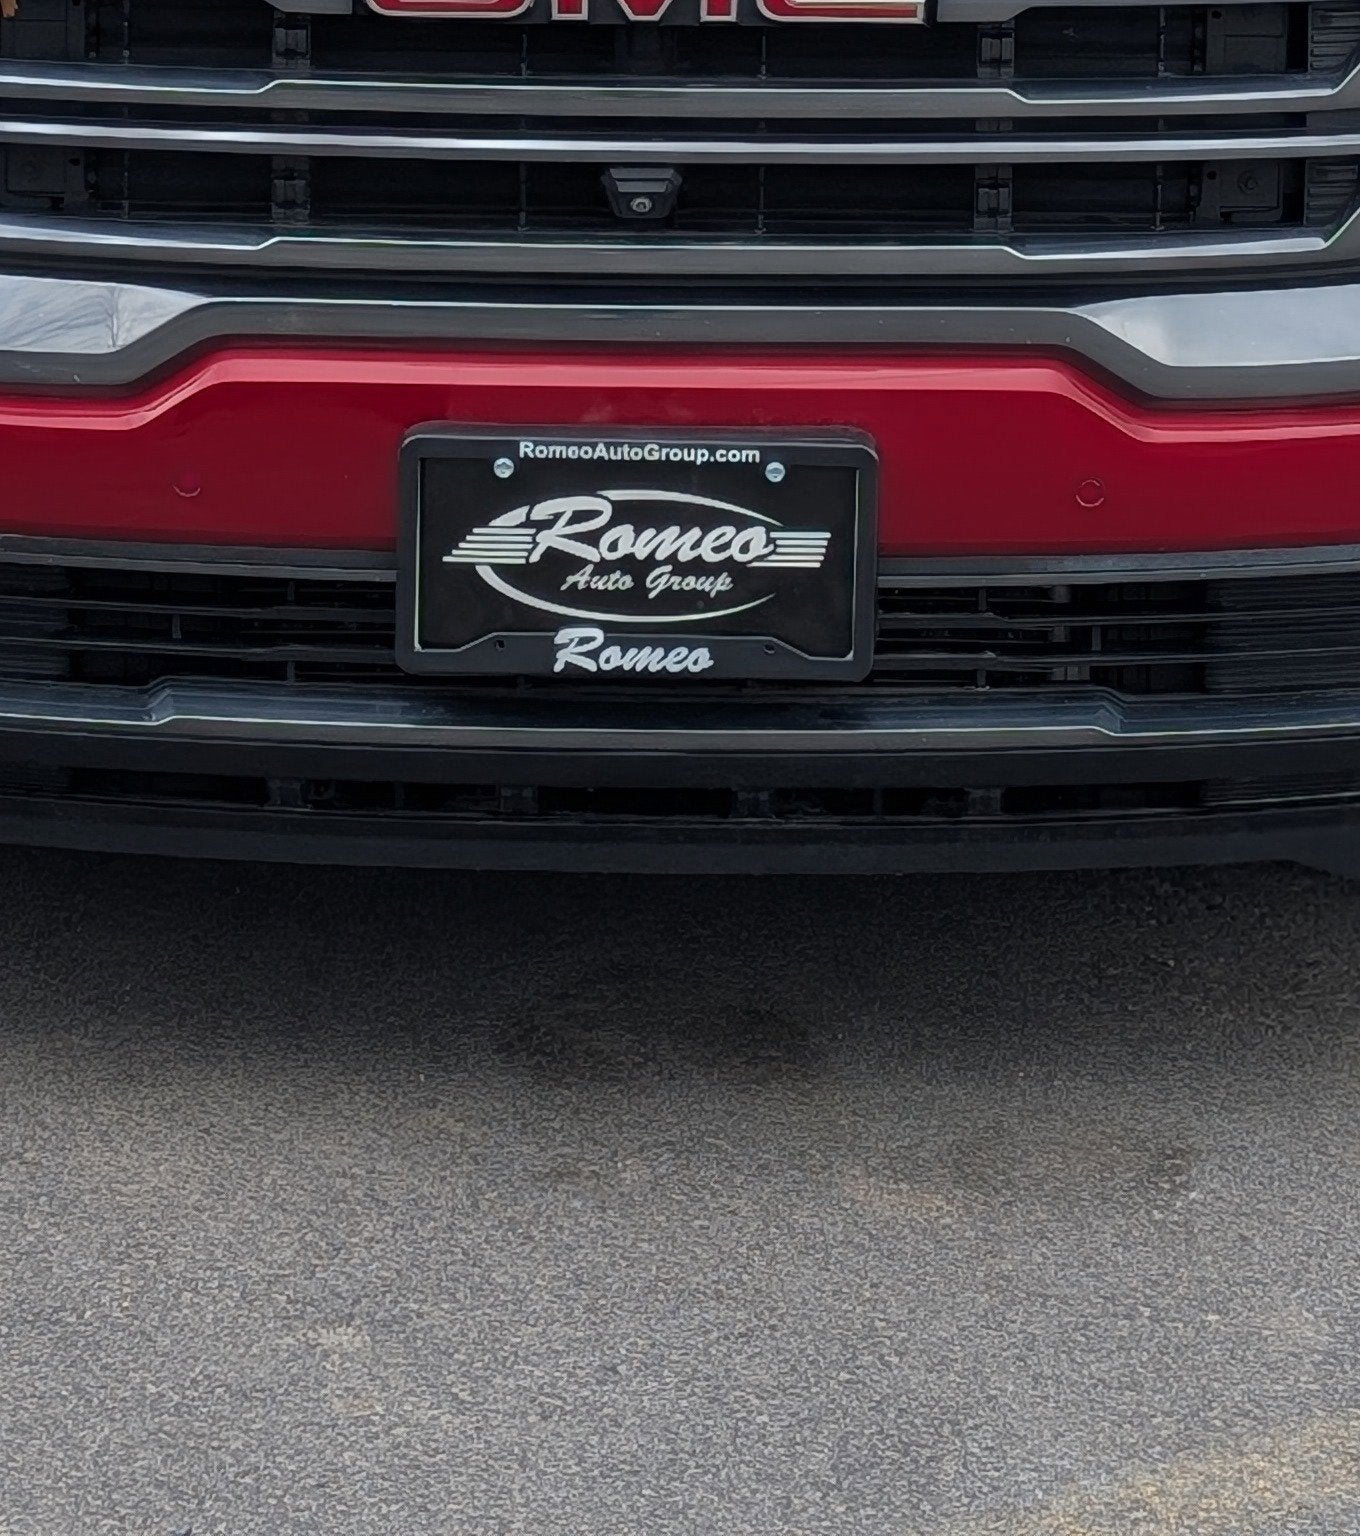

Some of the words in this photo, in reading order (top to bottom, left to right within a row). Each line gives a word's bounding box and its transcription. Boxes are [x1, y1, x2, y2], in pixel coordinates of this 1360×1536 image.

[519, 441, 760, 465] RomeoAutoGroup.com
[529, 495, 775, 563] Romeo
[560, 564, 634, 591] Auto
[645, 565, 733, 598] Group
[554, 627, 714, 673] Romeo
